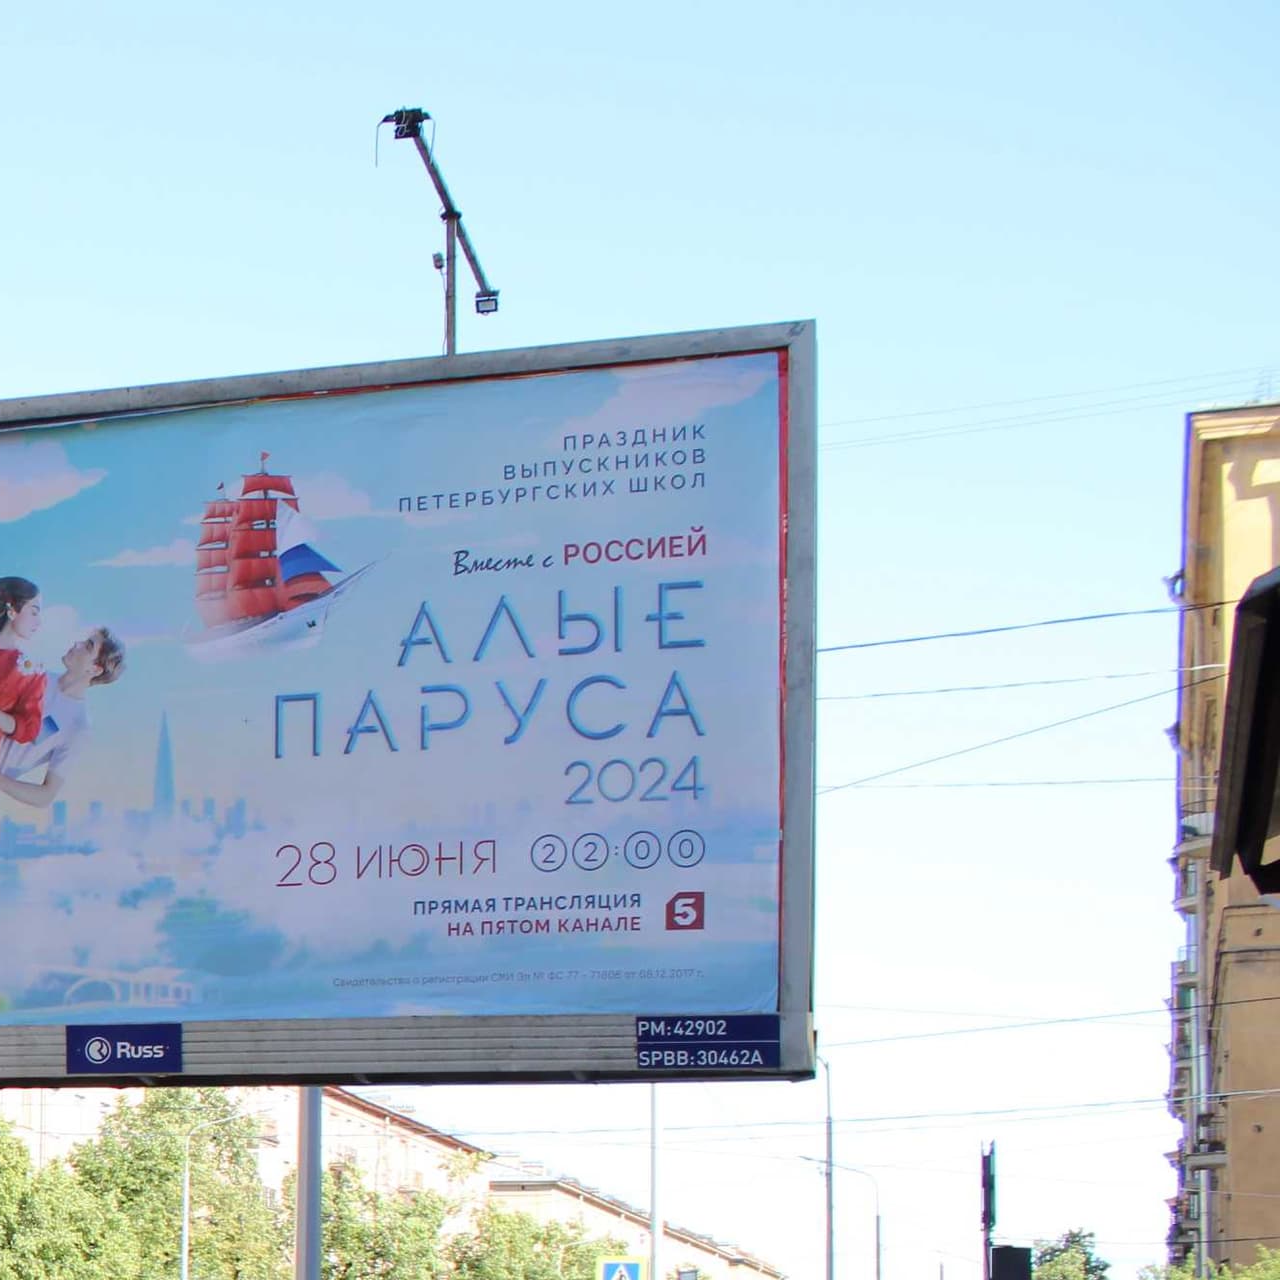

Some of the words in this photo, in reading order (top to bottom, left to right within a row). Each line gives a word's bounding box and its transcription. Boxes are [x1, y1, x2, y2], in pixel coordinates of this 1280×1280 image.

[563, 423, 706, 452] ПРАЗДНИК
[503, 447, 706, 481] ВЫПУСКНИКОВ
[398, 482, 615, 513] ПЕТЕРБУРГСКИХ
[628, 471, 706, 494] ШКОЛ
[452, 549, 535, 576] Вместе
[542, 555, 554, 568] с
[563, 525, 707, 566] РОССИЕЙ
[396, 579, 706, 667] АЛЫЕ
[274, 670, 706, 759] ПАРУСА
[563, 755, 706, 805] 2024
[275, 841, 337, 887] 28
[355, 839, 497, 881] ИЮНЯ
[530, 829, 706, 873] 22:00
[412, 897, 497, 916] ПРЯМАЯ
[502, 893, 641, 912] ТРАНСЛЯЦИЯ
[446, 921, 475, 937] НА
[480, 919, 550, 936] ПЯТОМ
[557, 916, 641, 934] КАНАЛЕ
[638, 1019, 728, 1037] PM:42902
[116, 1041, 165, 1059] Russ
[639, 1049, 764, 1066] SPBB:30462A
